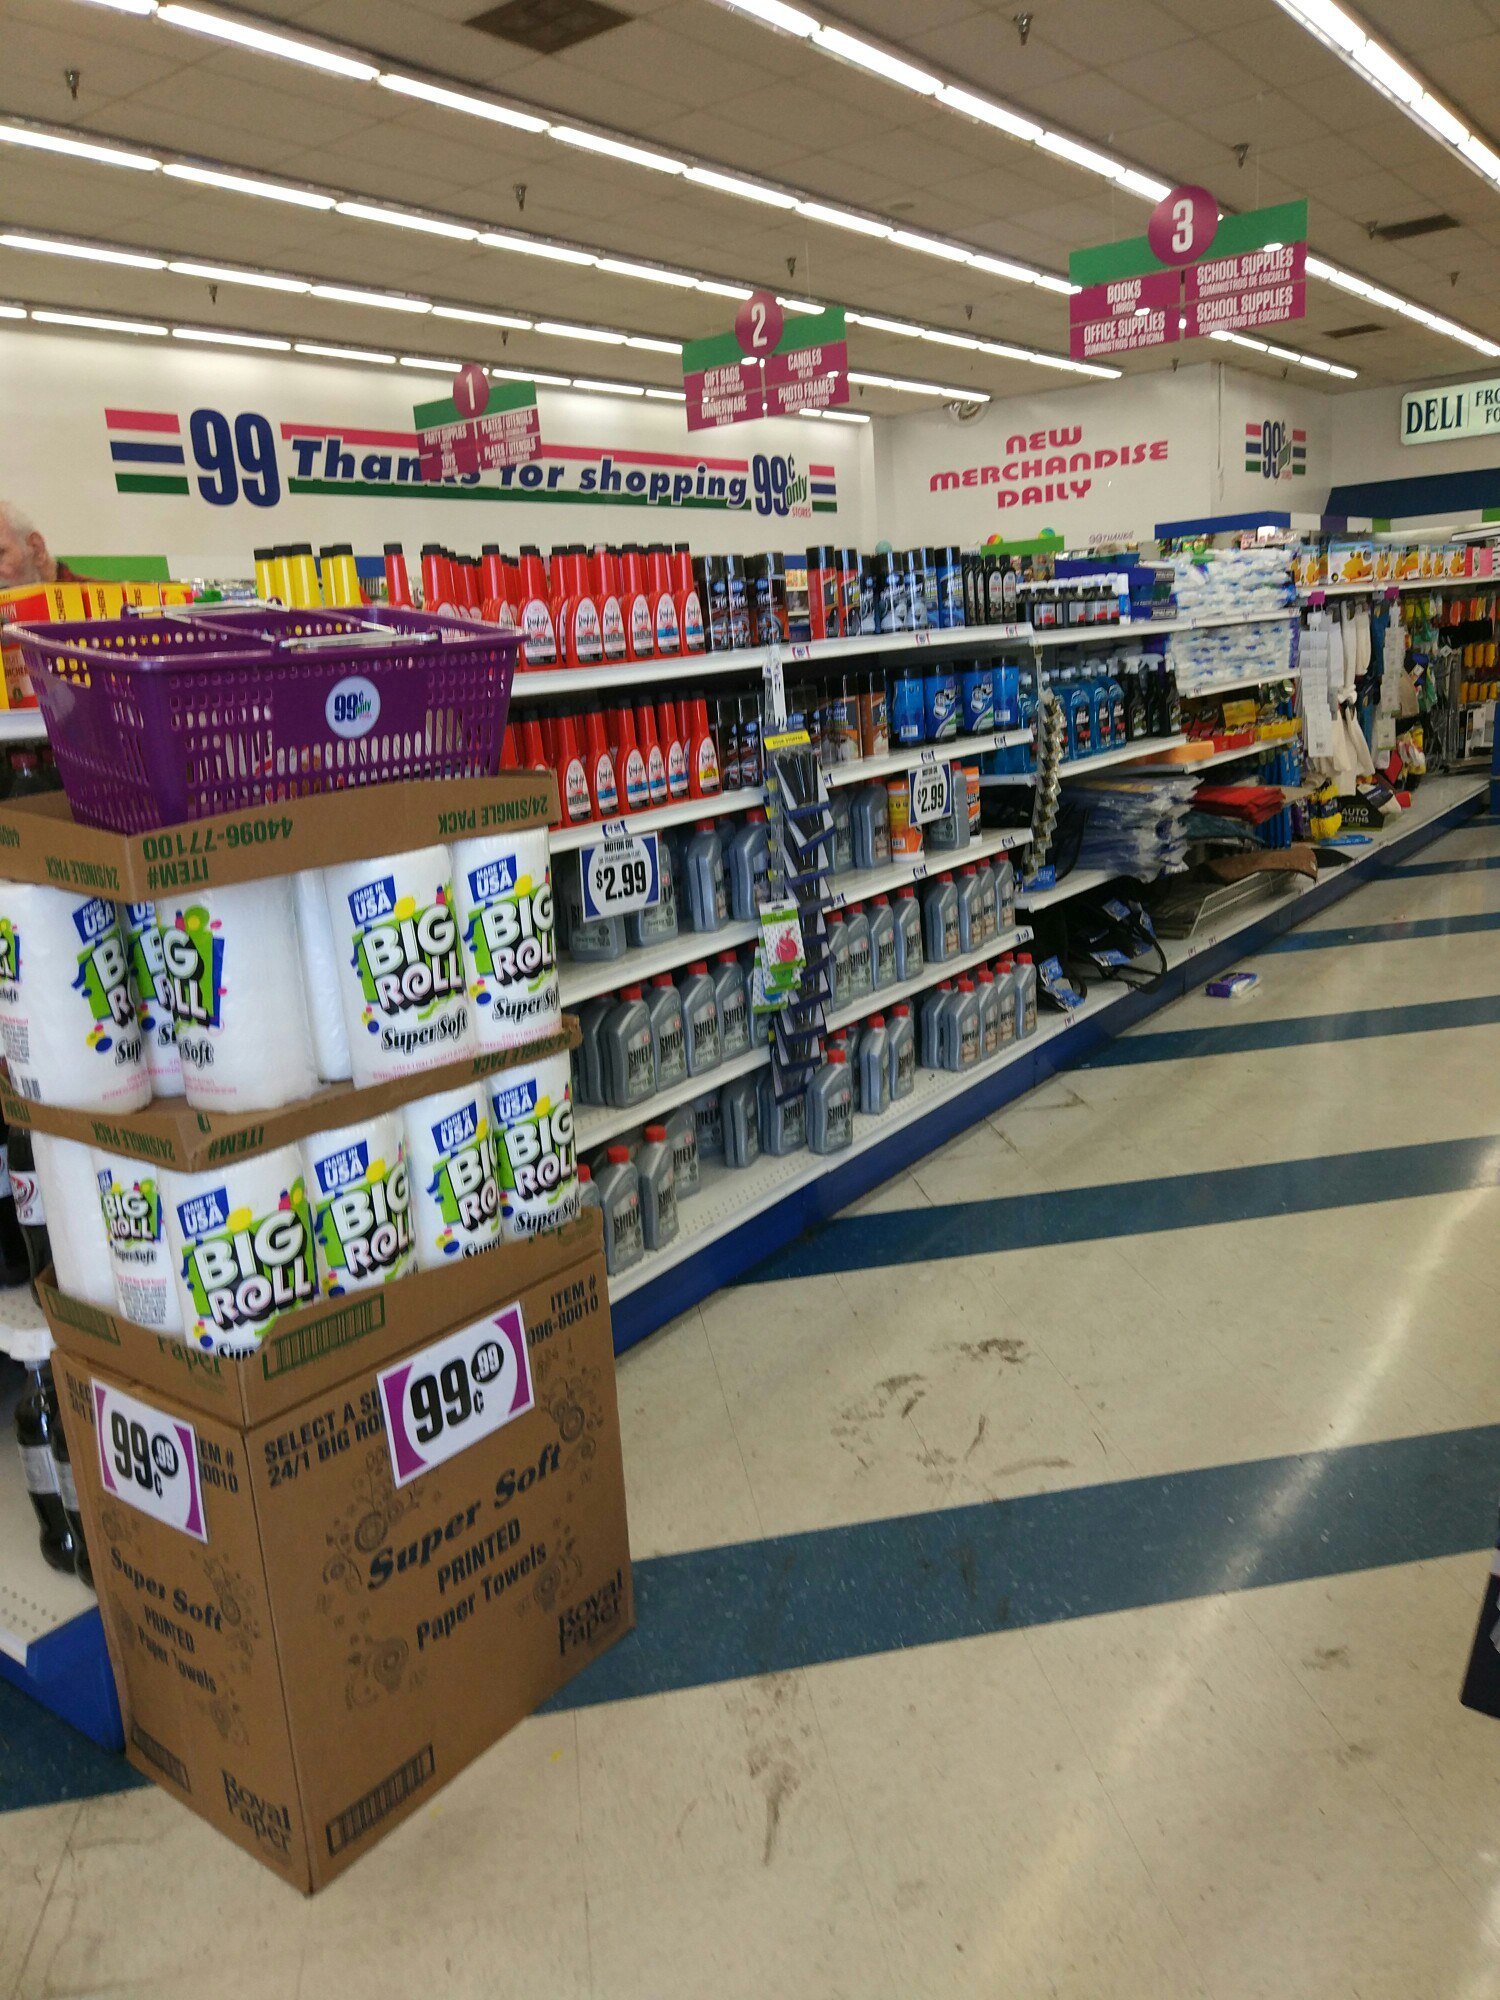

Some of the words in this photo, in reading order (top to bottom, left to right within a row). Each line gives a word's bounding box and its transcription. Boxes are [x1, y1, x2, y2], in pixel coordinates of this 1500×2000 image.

[1172, 198, 1194, 253] 3
[1197, 260, 1239, 285] SCHOOL
[1241, 247, 1294, 274] SUPPLIES
[1107, 279, 1142, 304] BOOKS
[1197, 298, 1239, 322] SCHOOL
[1241, 286, 1293, 313] SUPPLIES
[751, 302, 768, 348] 2
[1084, 320, 1116, 344] OFFICE
[1118, 311, 1165, 338] SUPPLIES
[788, 348, 822, 371] CANDLES
[465, 372, 475, 410] 1
[704, 370, 720, 388] GIFT
[778, 383, 803, 404] PHOTO
[804, 377, 835, 399] FRAMES
[702, 395, 748, 419] DINNERWARE
[1405, 393, 1465, 435] DELI
[424, 431, 442, 447] PARTY
[1006, 425, 1082, 455] NEW
[190, 408, 281, 508] 99
[292, 437, 481, 485] Thans
[580, 458, 748, 508] shopping
[930, 440, 1169, 492] MERCHANDISE
[786, 474, 807, 508] only
[997, 479, 1092, 509] DAILY
[482, 796, 549, 827] 24/SINGLE
[918, 783, 944, 814] $2.99
[1341, 807, 1369, 816] AUTO
[438, 808, 476, 834] PACK
[143, 816, 293, 862] 44096-77100
[45, 855, 71, 882] PACK
[72, 859, 120, 891] 24/SINGLE
[147, 855, 209, 890] ITEM#
[476, 866, 499, 880] MADE
[499, 860, 508, 871] IN
[477, 871, 513, 899] USA
[595, 860, 647, 901] $2.99
[353, 885, 374, 903] MADE
[374, 881, 385, 895] IN
[354, 893, 392, 924] USA
[481, 882, 554, 950] BIG
[363, 903, 456, 978] BIG
[374, 951, 463, 1012] ROLL
[501, 1097, 533, 1119] USA
[441, 1119, 476, 1150] USA
[504, 1100, 574, 1166] BIG
[323, 1153, 349, 1171] MADE
[325, 1161, 364, 1188] USA
[101, 1189, 149, 1218] BIG
[331, 1161, 410, 1241] BIG
[184, 1206, 226, 1236] USA
[194, 1209, 304, 1291] BIG
[207, 1257, 312, 1325] ROLL
[551, 1279, 585, 1313] ITEM
[264, 1410, 336, 1465] SELECT
[343, 1401, 356, 1424] A
[268, 1451, 311, 1489] 24/1
[317, 1433, 351, 1464] BIG
[367, 1500, 482, 1592] Super
[494, 1441, 561, 1510] Soft
[437, 1517, 521, 1596] PRINTED
[110, 1547, 167, 1600] Super
[172, 1588, 223, 1633] Soft
[416, 1591, 477, 1651] Paper
[481, 1541, 548, 1602] Towels
[143, 1603, 195, 1655] PRINTED
